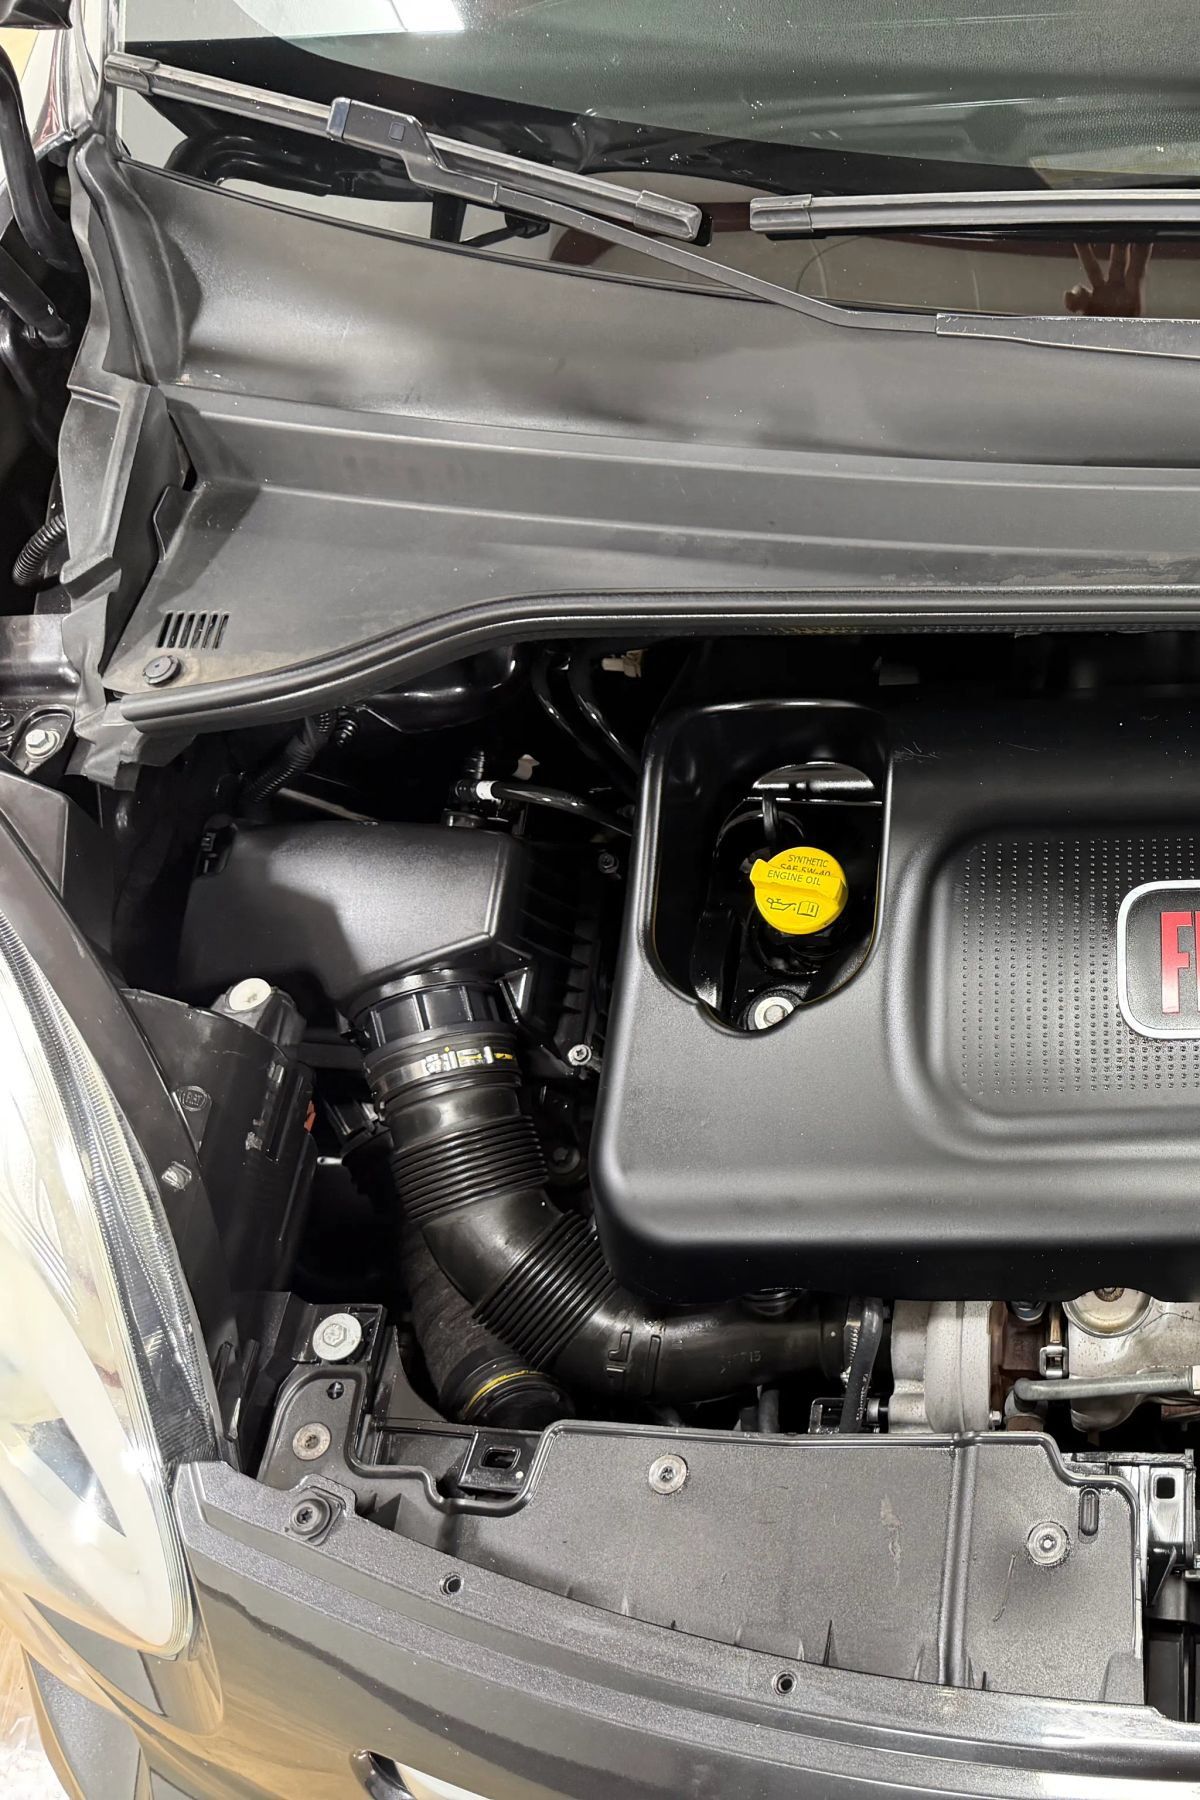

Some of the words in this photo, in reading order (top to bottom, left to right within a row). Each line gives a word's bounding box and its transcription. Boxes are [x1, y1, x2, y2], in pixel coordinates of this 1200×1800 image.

[788, 855, 829, 867] SYNTHETIC
[767, 870, 803, 882] ENGINE
[806, 876, 821, 885] OIL
